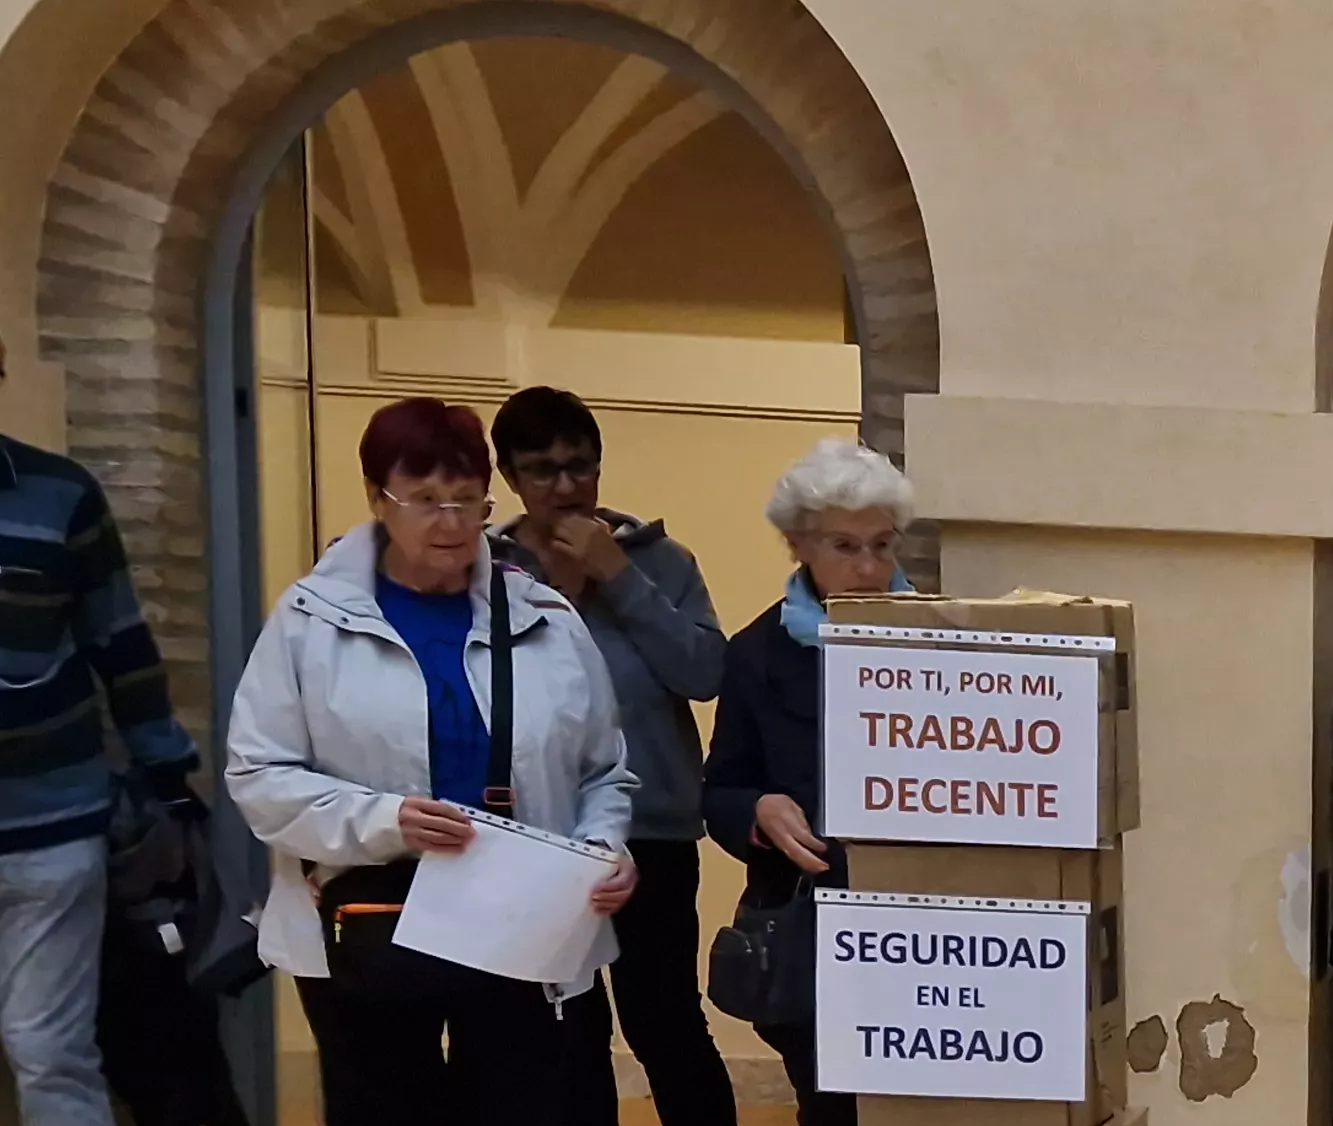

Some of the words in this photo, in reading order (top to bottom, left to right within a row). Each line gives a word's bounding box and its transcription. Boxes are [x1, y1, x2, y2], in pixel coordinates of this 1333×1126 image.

[858, 667, 912, 691] POR
[920, 669, 951, 696] TI,
[960, 671, 1012, 696] POR
[1021, 674, 1063, 700] MI,
[859, 711, 1061, 755] TRABAJO
[864, 776, 1059, 818] DECENTE
[834, 930, 1067, 970] SEGURIDAD
[916, 985, 950, 1008] EN
[958, 986, 986, 1009] EL
[856, 1025, 1044, 1064] TRABAJO
